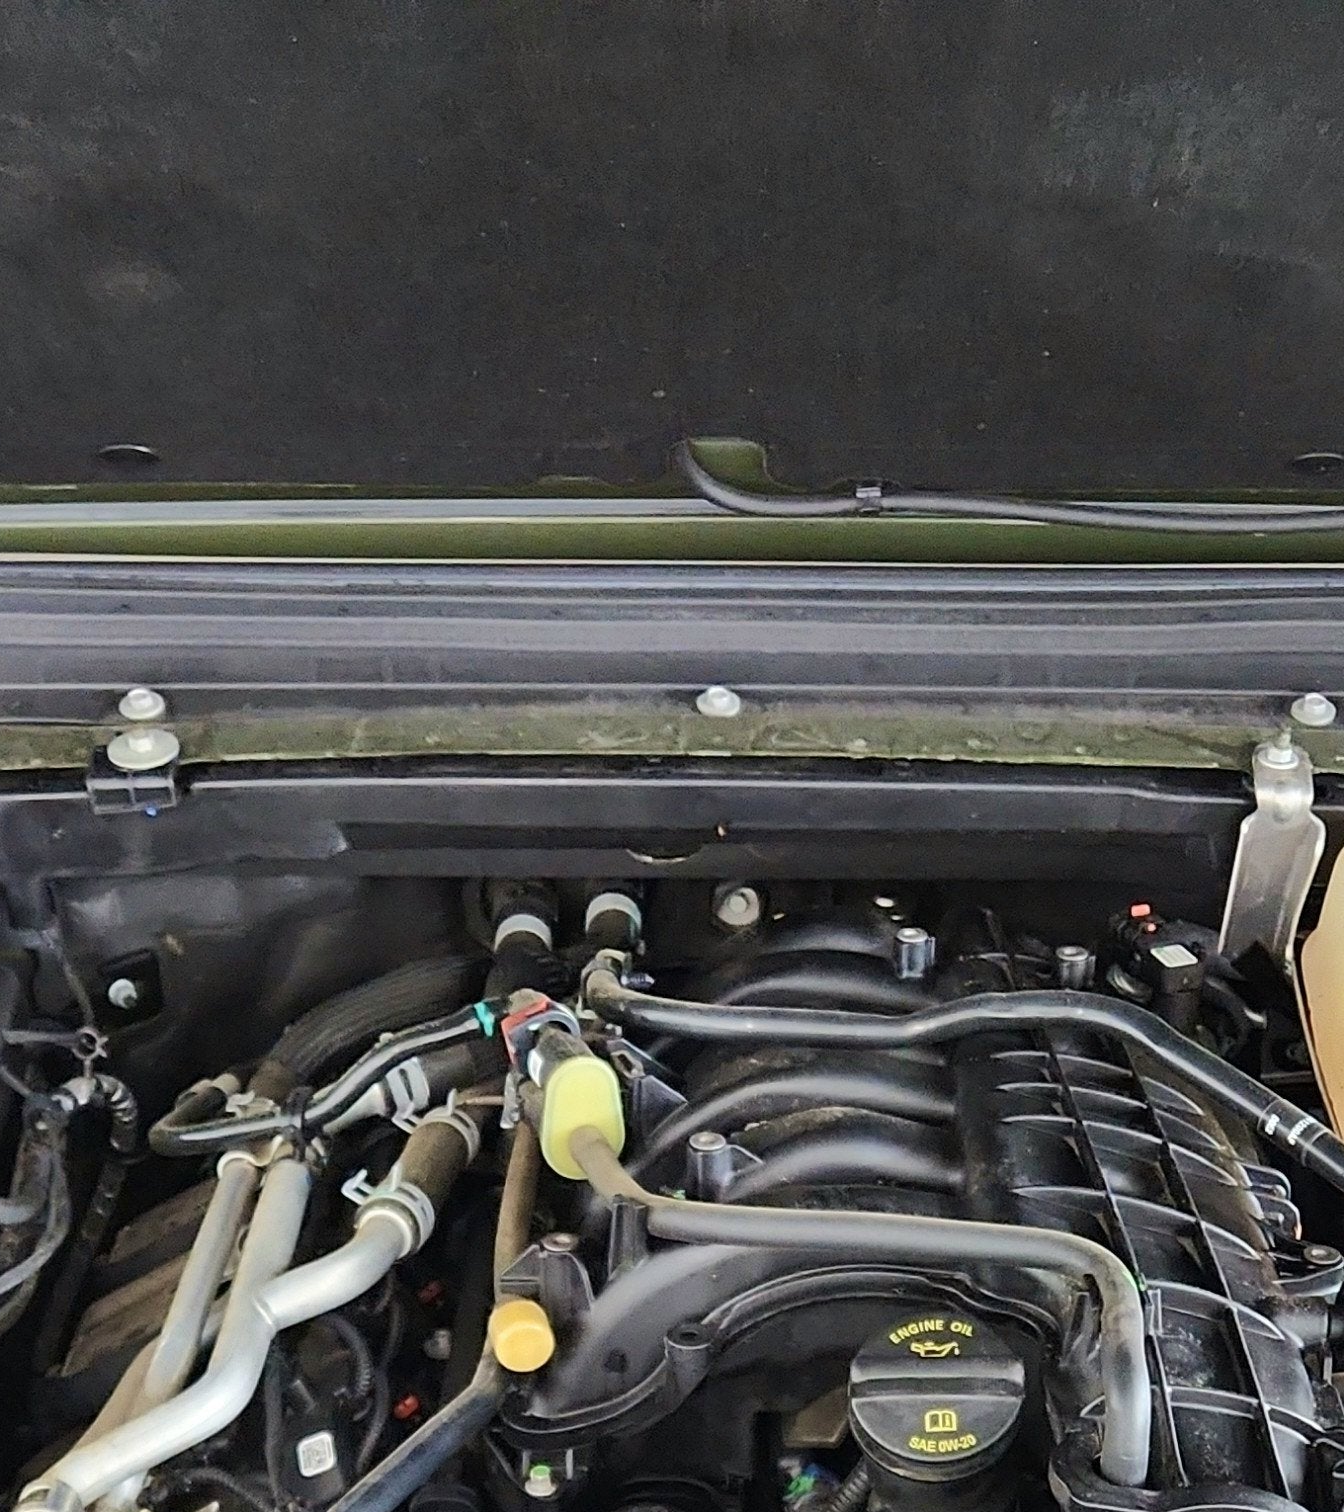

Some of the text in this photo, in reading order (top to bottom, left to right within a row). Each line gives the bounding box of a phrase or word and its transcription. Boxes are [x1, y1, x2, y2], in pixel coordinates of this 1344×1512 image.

[889, 1319, 973, 1344] ENGINE OIL
[909, 1434, 977, 1453] SAE 0W-20
